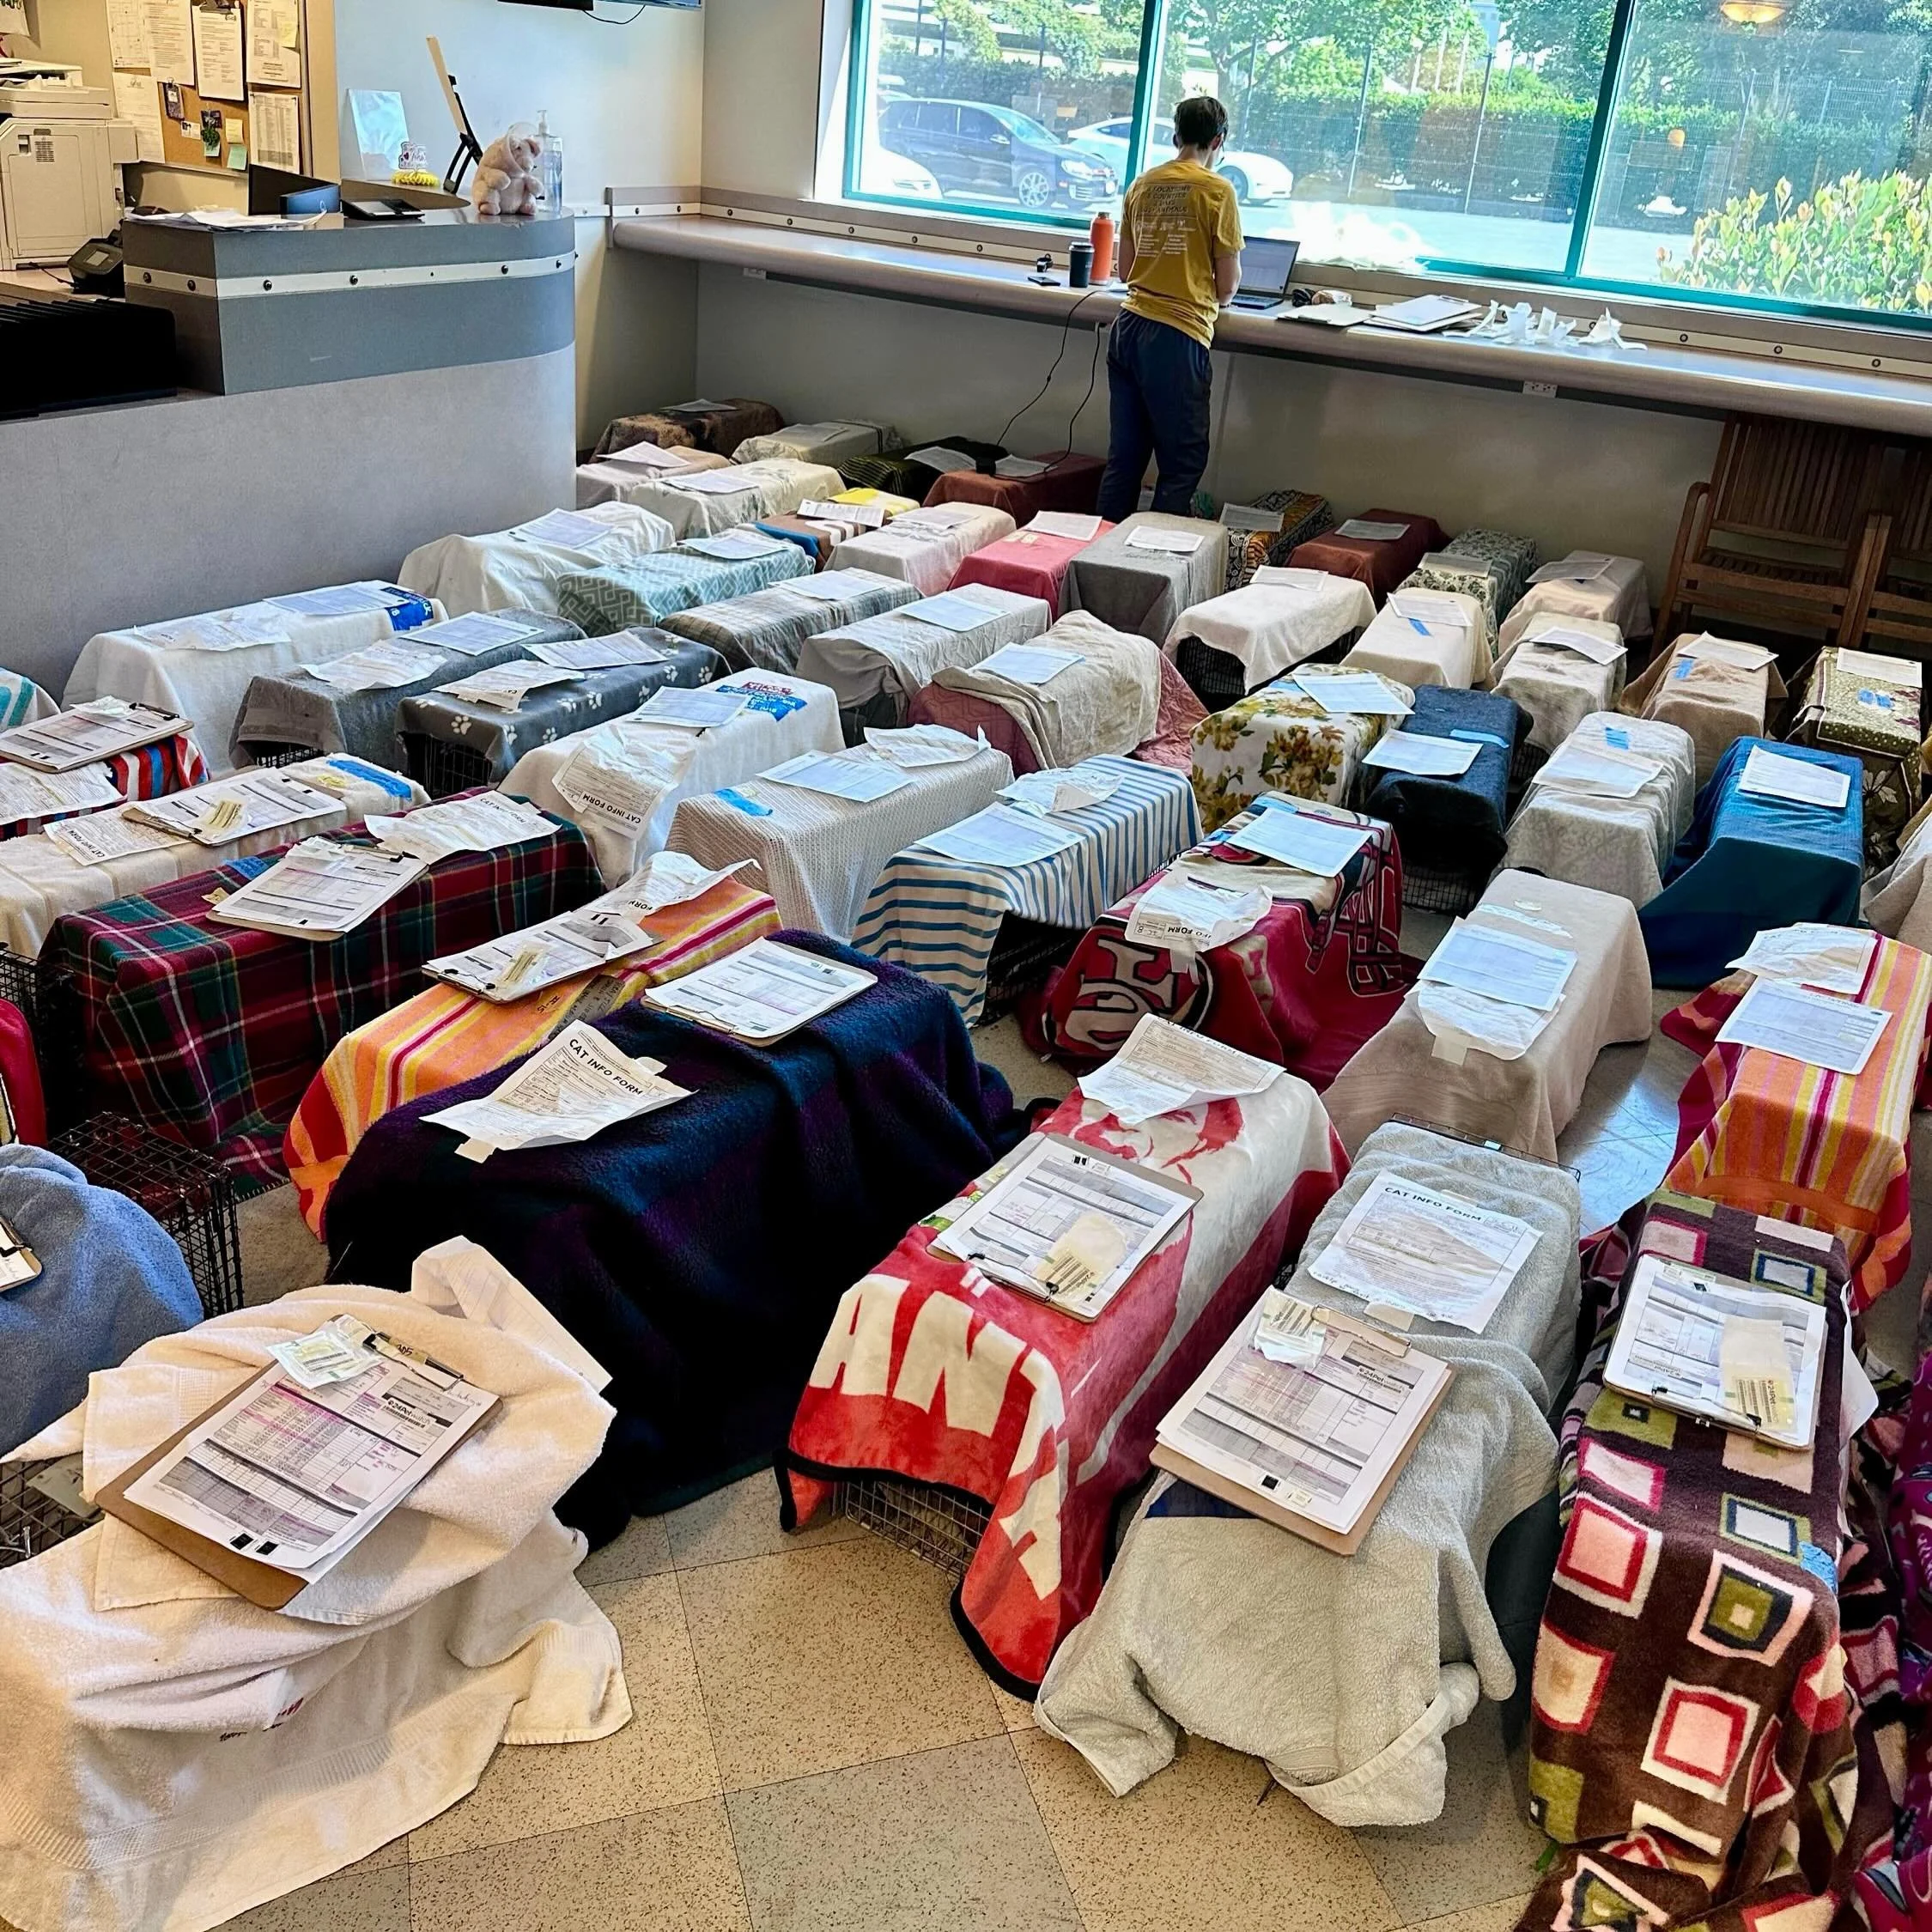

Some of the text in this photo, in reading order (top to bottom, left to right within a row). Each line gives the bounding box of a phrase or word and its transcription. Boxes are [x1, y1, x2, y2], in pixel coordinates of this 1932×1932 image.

[583, 793, 641, 823] CAT INFO FORM
[68, 829, 82, 842] FORM
[92, 848, 105, 857] CAT
[569, 1038, 644, 1097] CAT INFO FORM
[1384, 1187, 1482, 1221] CAT INFO FORM
